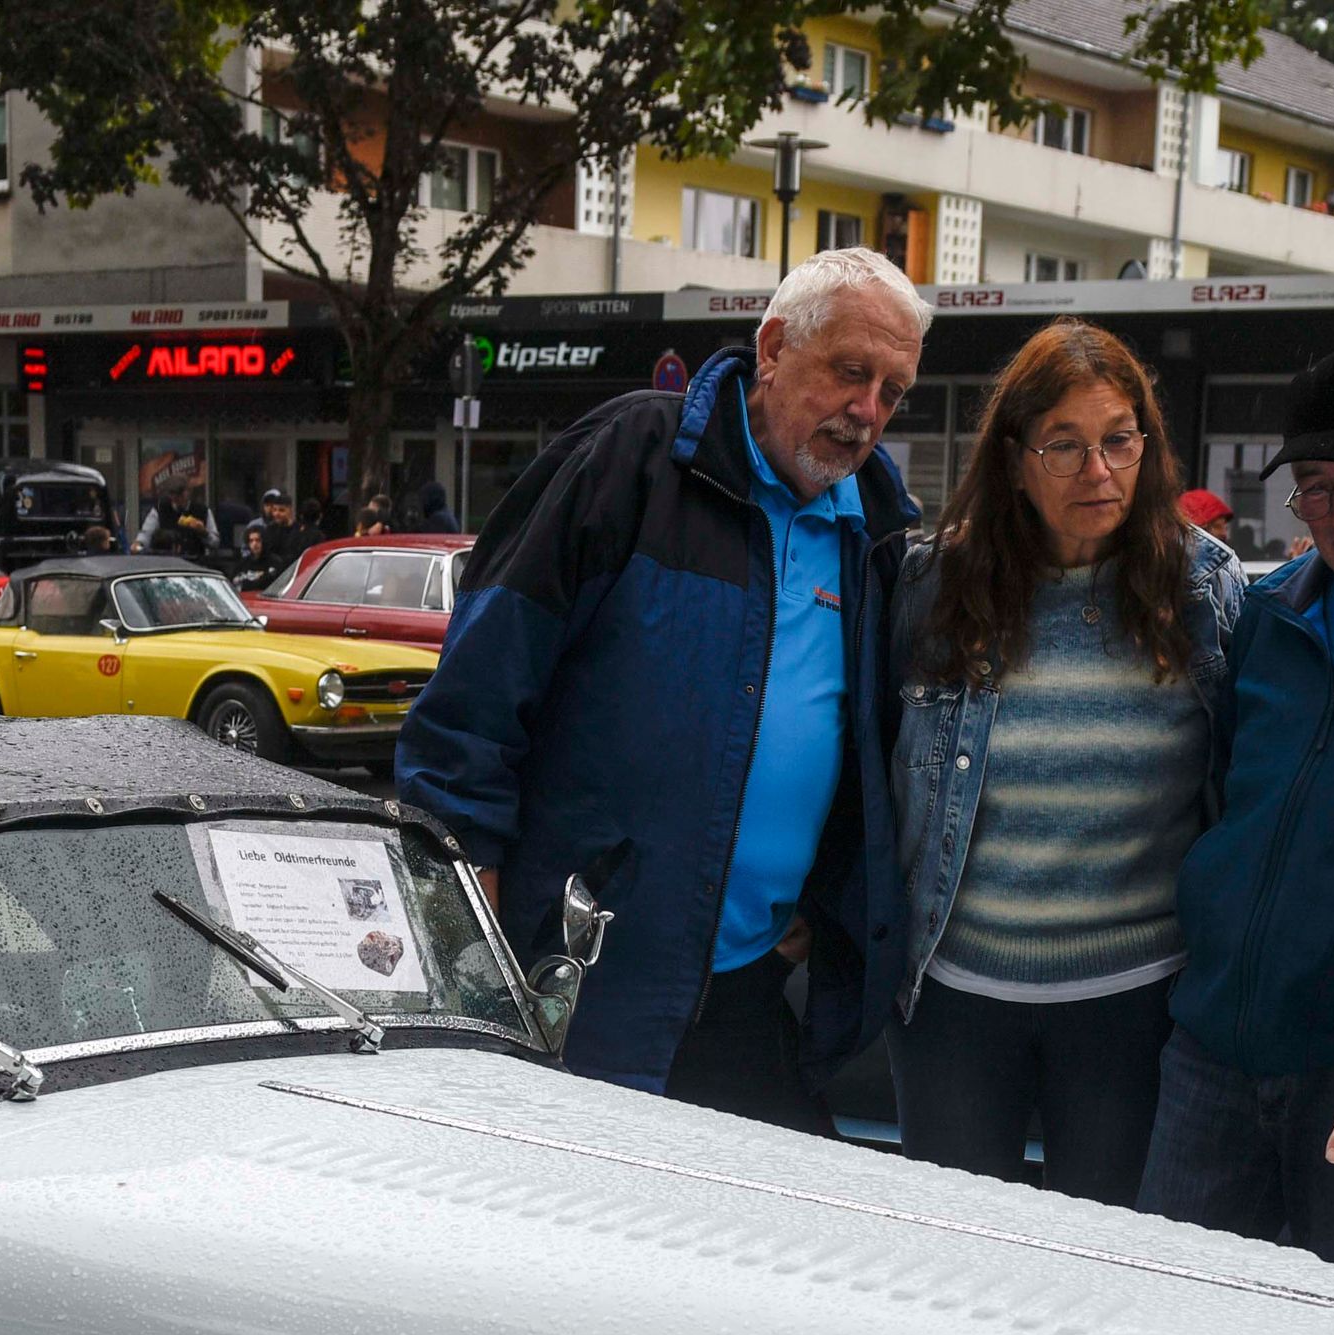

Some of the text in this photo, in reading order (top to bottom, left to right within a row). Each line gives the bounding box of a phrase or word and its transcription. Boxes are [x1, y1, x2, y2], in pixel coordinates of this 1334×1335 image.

[130, 309, 183, 325] MILANO
[450, 303, 504, 319] tipster
[147, 346, 265, 377] MILANO
[497, 342, 605, 372] tipster
[238, 850, 357, 868] Liebe Oldtimerfreunde
